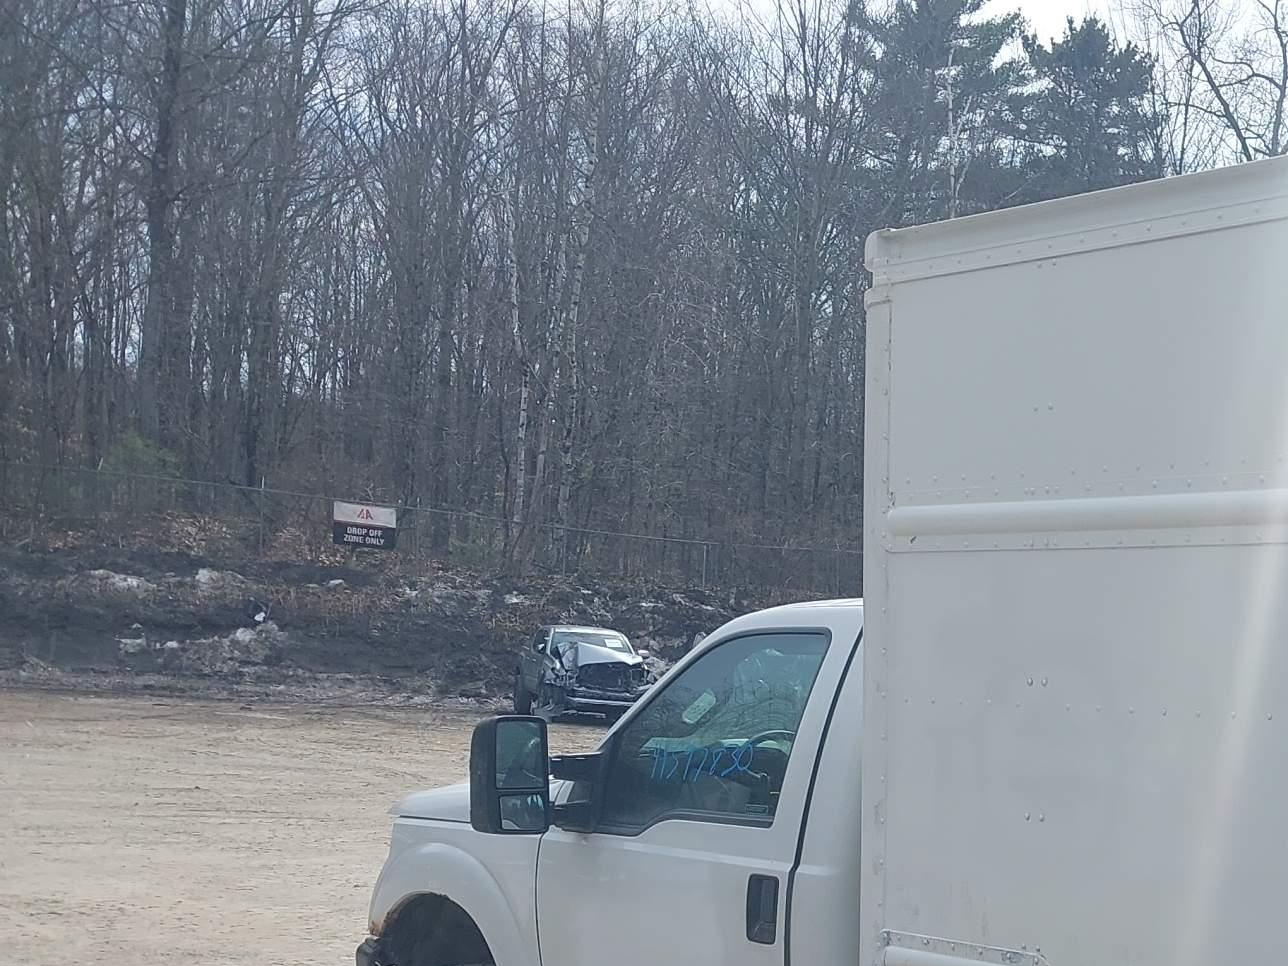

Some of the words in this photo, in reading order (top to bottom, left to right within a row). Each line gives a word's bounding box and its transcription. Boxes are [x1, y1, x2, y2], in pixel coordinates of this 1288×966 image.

[346, 526, 367, 536] DROP
[368, 529, 383, 537] OFF
[343, 534, 365, 543] ZONE
[365, 536, 385, 545] ONLY
